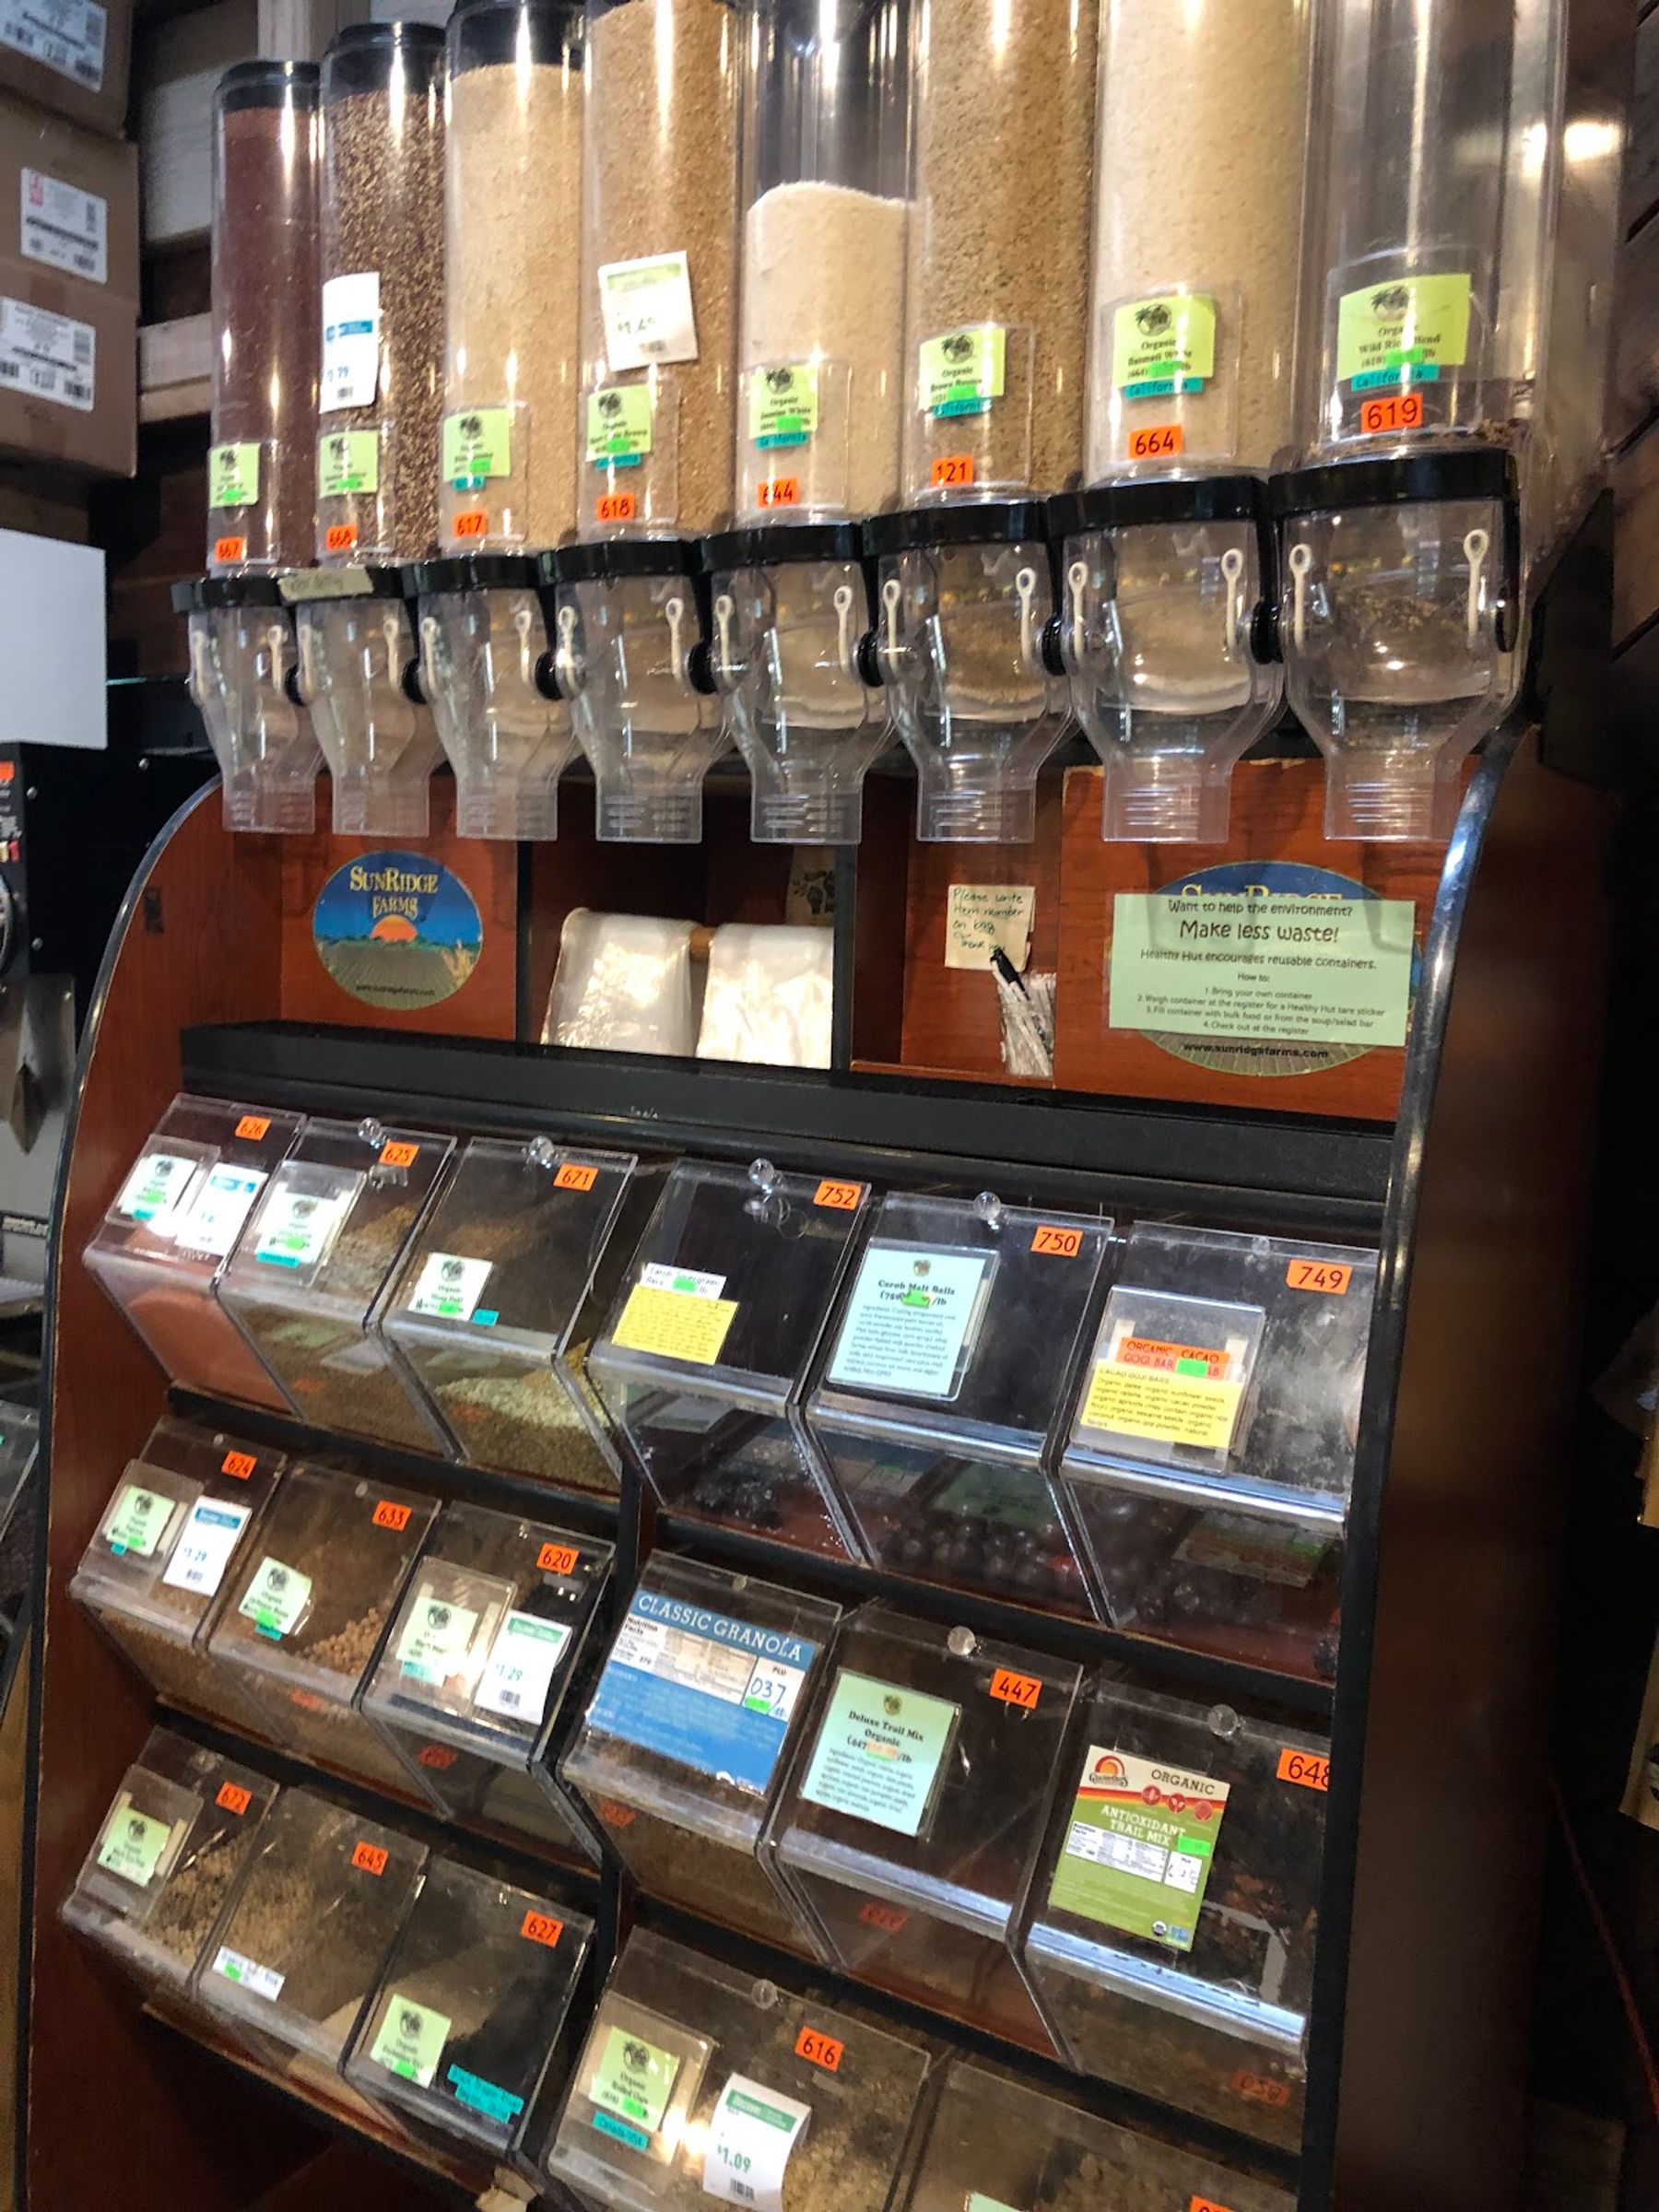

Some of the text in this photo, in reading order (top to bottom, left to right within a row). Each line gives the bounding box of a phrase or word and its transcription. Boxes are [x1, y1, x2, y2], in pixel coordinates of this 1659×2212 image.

[1356, 367, 1423, 388] Califoria
[1367, 397, 1418, 430] 619
[1135, 431, 1175, 456] 664
[936, 462, 967, 483] 121
[600, 499, 630, 519] 618
[456, 514, 483, 536] 617
[348, 865, 440, 894] SUNRIDGE
[952, 887, 989, 902] Please
[371, 895, 418, 921] FARMS
[1168, 899, 1354, 917] Want to help the environment?
[1179, 920, 1339, 943] Make less waste!
[1140, 948, 1377, 970] Healthy Hut encourages reusable containers.
[1237, 972, 1257, 982] How
[562, 1169, 591, 1185] 671
[821, 1185, 855, 1206] 752
[1038, 1231, 1077, 1253] 750
[877, 1278, 906, 1290] Carob
[932, 1284, 956, 1296] Balls
[1298, 1265, 1344, 1289] 749
[1126, 1340, 1219, 1365] ORGANIC CACAO
[378, 1508, 405, 1526] 633
[542, 1551, 571, 1570] 620
[638, 1594, 802, 1663] CLASSIC GRANOLA
[750, 1677, 786, 1704] 037
[997, 1679, 1038, 1703] 447
[848, 1710, 924, 1742] Deluxe Trail Mix
[864, 1728, 901, 1747] Organic
[1151, 1769, 1216, 1795] ORGANIC
[1100, 1805, 1186, 1836] ANTIOXIDANT
[1109, 1818, 1172, 1847] TRAIL MIX
[528, 1918, 558, 1941] 627
[803, 2035, 835, 2065] 616
[717, 2143, 752, 2174] $1.09
